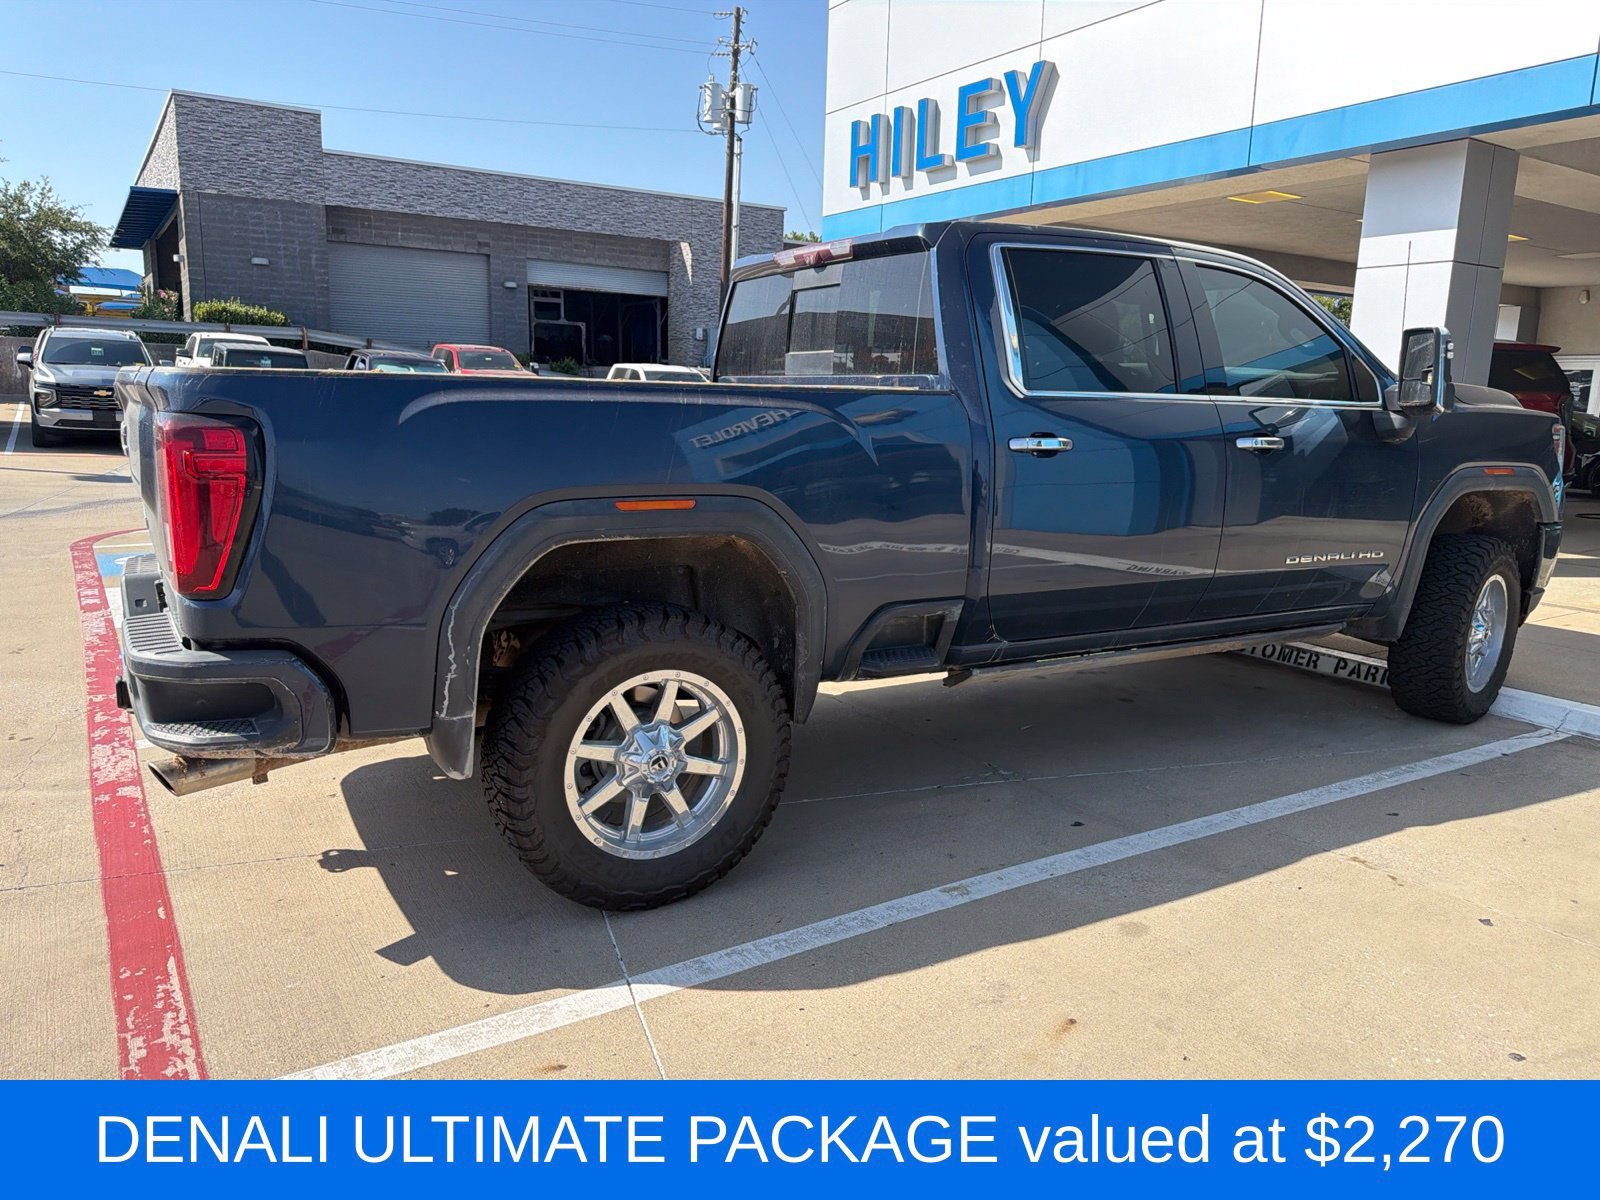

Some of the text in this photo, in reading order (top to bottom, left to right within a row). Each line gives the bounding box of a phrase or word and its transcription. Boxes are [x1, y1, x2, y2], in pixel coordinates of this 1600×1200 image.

[849, 60, 1059, 188] HILEY
[1285, 550, 1384, 565] DENALI HD
